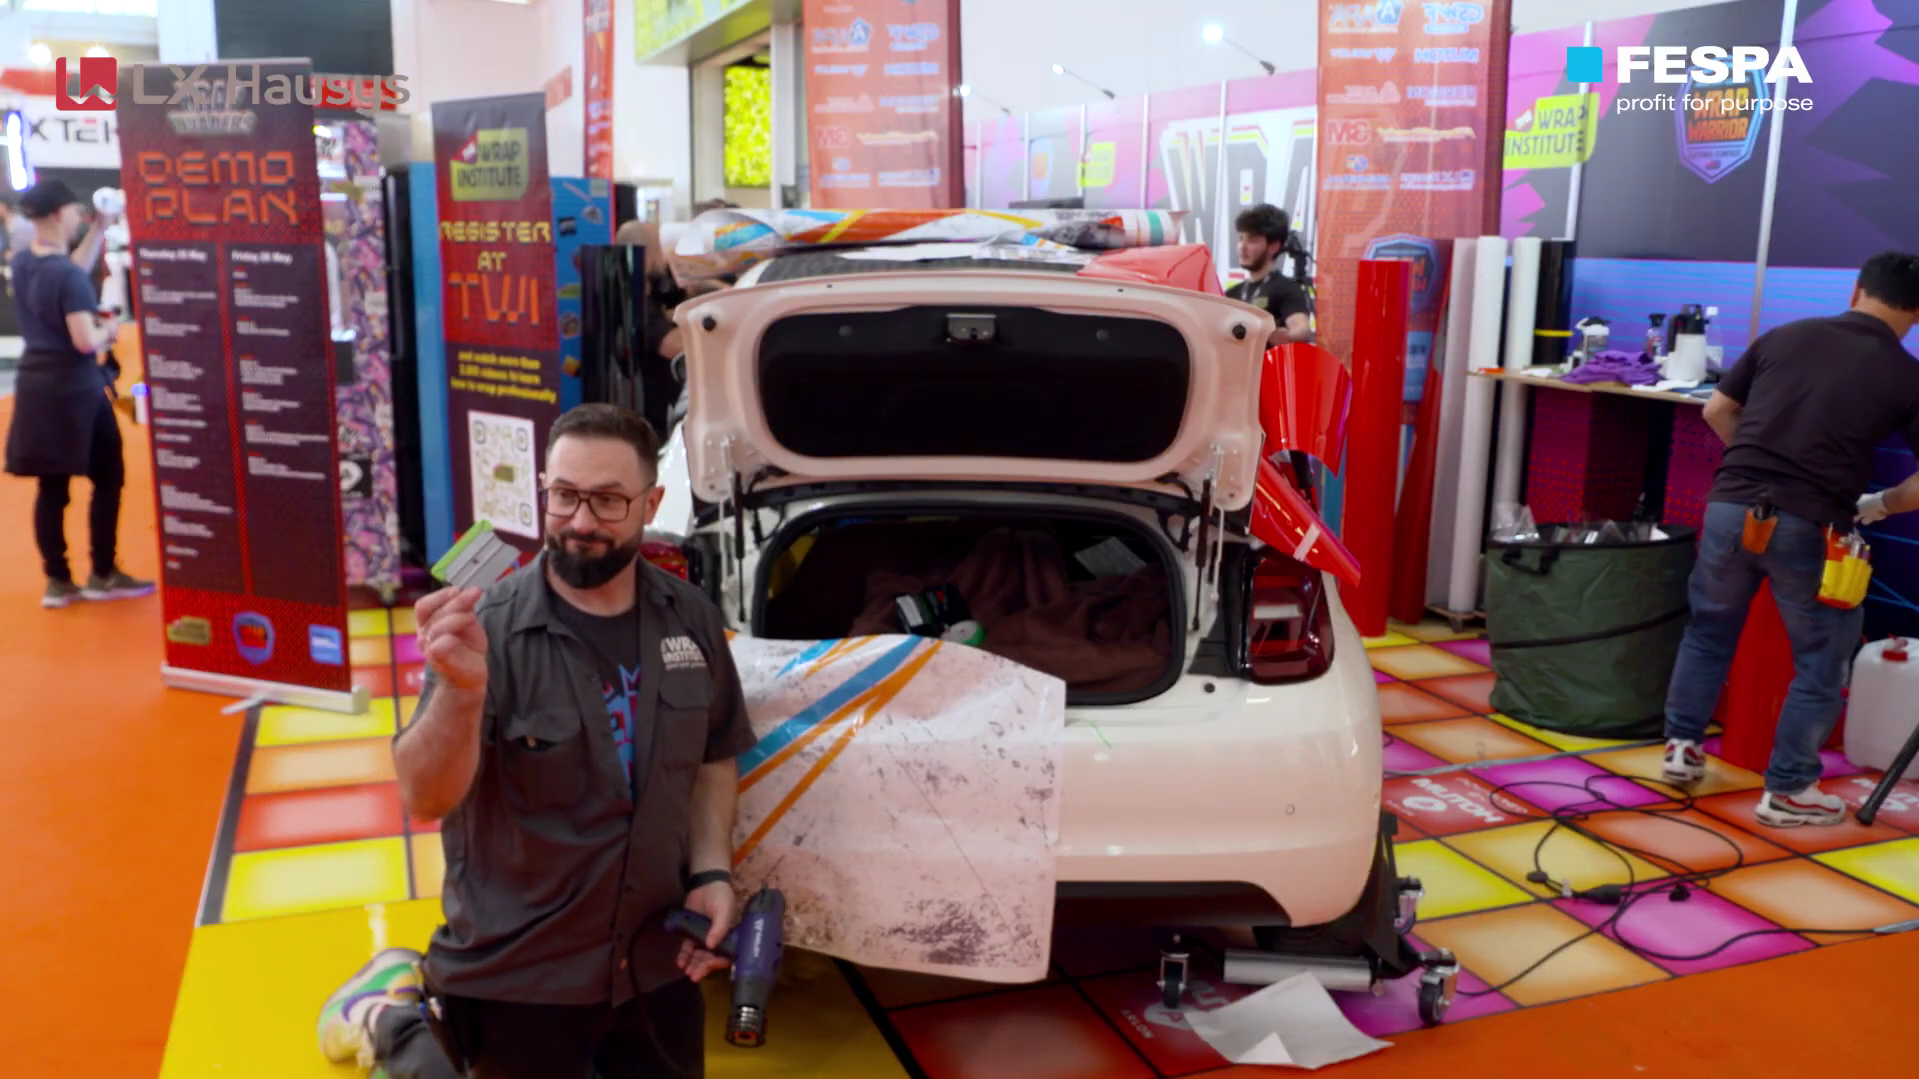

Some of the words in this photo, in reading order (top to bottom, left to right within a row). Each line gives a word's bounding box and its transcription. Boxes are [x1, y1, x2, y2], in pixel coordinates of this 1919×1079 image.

[478, 139, 522, 163] WRAP
[1503, 129, 1585, 158] INSTITUTE
[137, 151, 296, 187] DEMO
[456, 166, 522, 189] INSTITUTE
[146, 188, 300, 226] PLAN
[439, 220, 551, 244] REGISTER
[477, 251, 507, 273] AT
[449, 272, 540, 328] TWI
